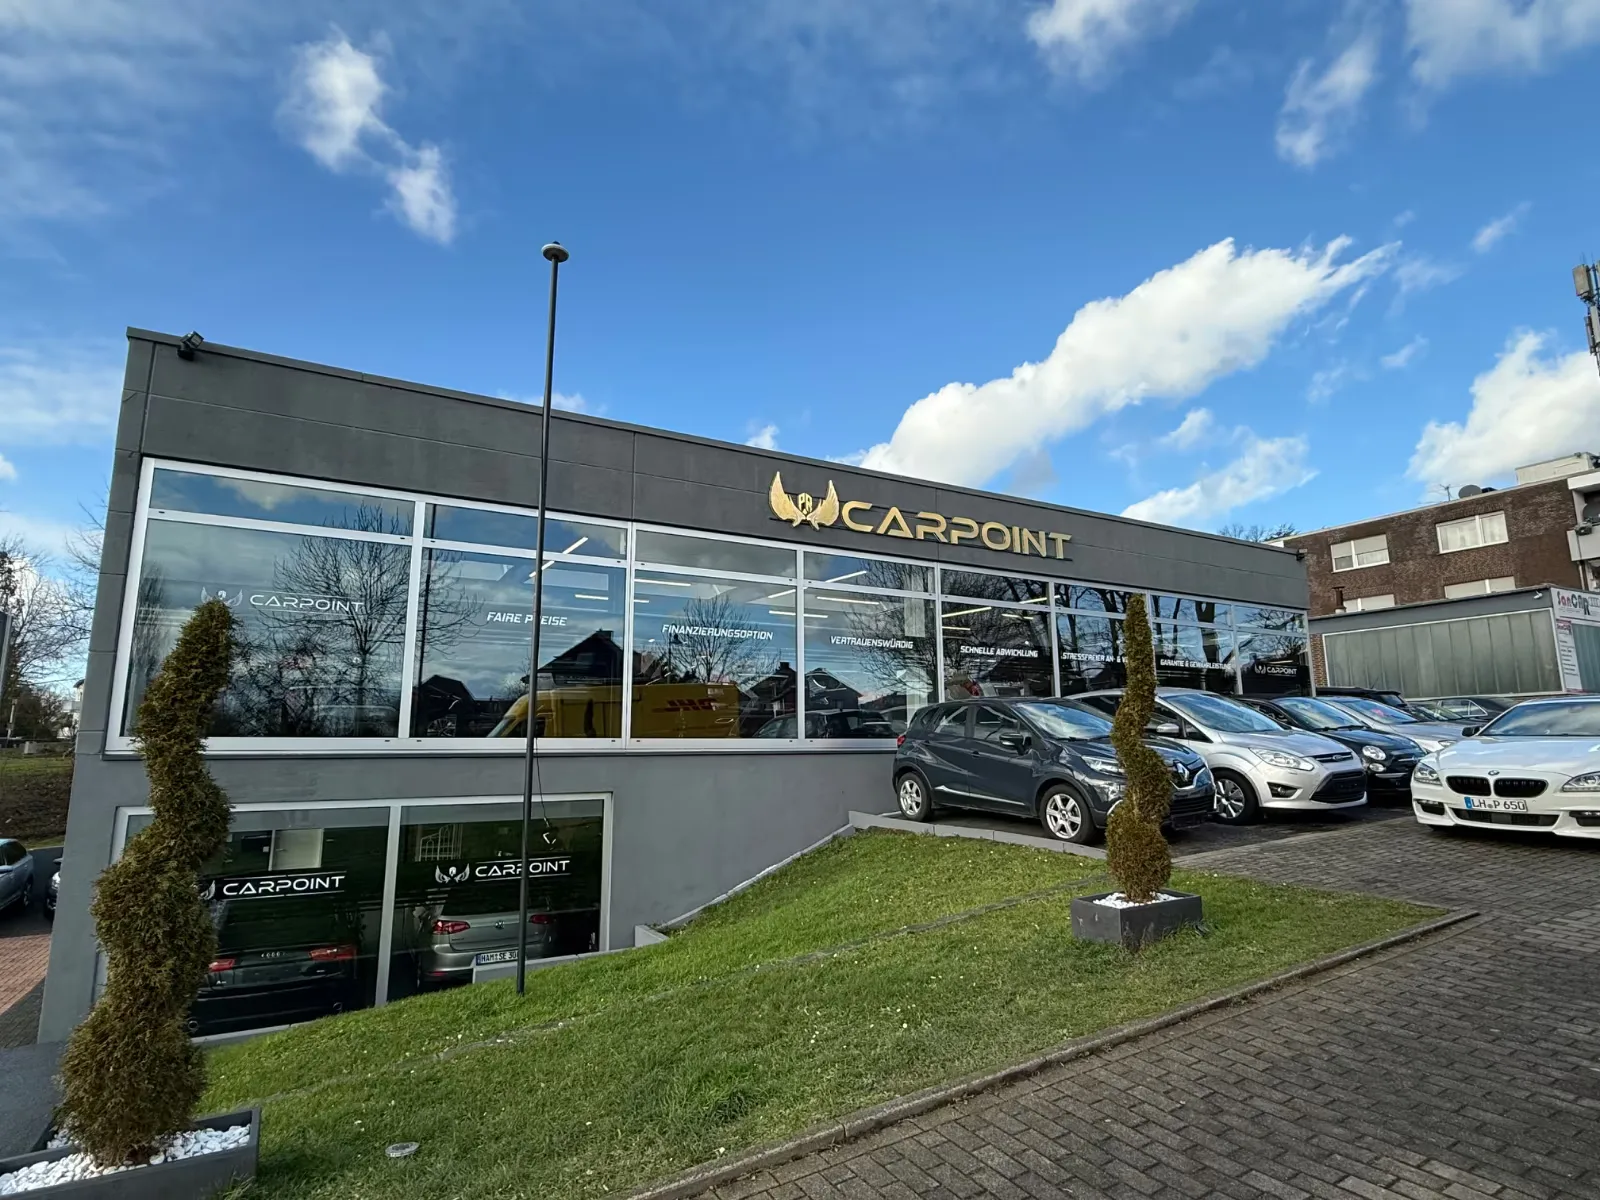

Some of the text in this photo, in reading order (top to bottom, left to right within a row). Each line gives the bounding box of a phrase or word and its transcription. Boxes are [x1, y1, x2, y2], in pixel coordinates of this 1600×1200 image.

[841, 500, 1073, 560] CARPOINT
[250, 594, 364, 613] CARPOINT
[486, 611, 568, 627] FAIRE PEISE
[662, 624, 774, 640] FINANZIERUNGSOPTION
[830, 635, 914, 649] VERTRAUENSWÜRDIG
[960, 645, 1039, 658] SCHNELLE ABWICKLUNG
[1160, 659, 1184, 667] GARANTIE
[1267, 666, 1297, 675] CARPOINT
[1472, 799, 1526, 811] LH P 650
[223, 876, 346, 896] CARPOINT
